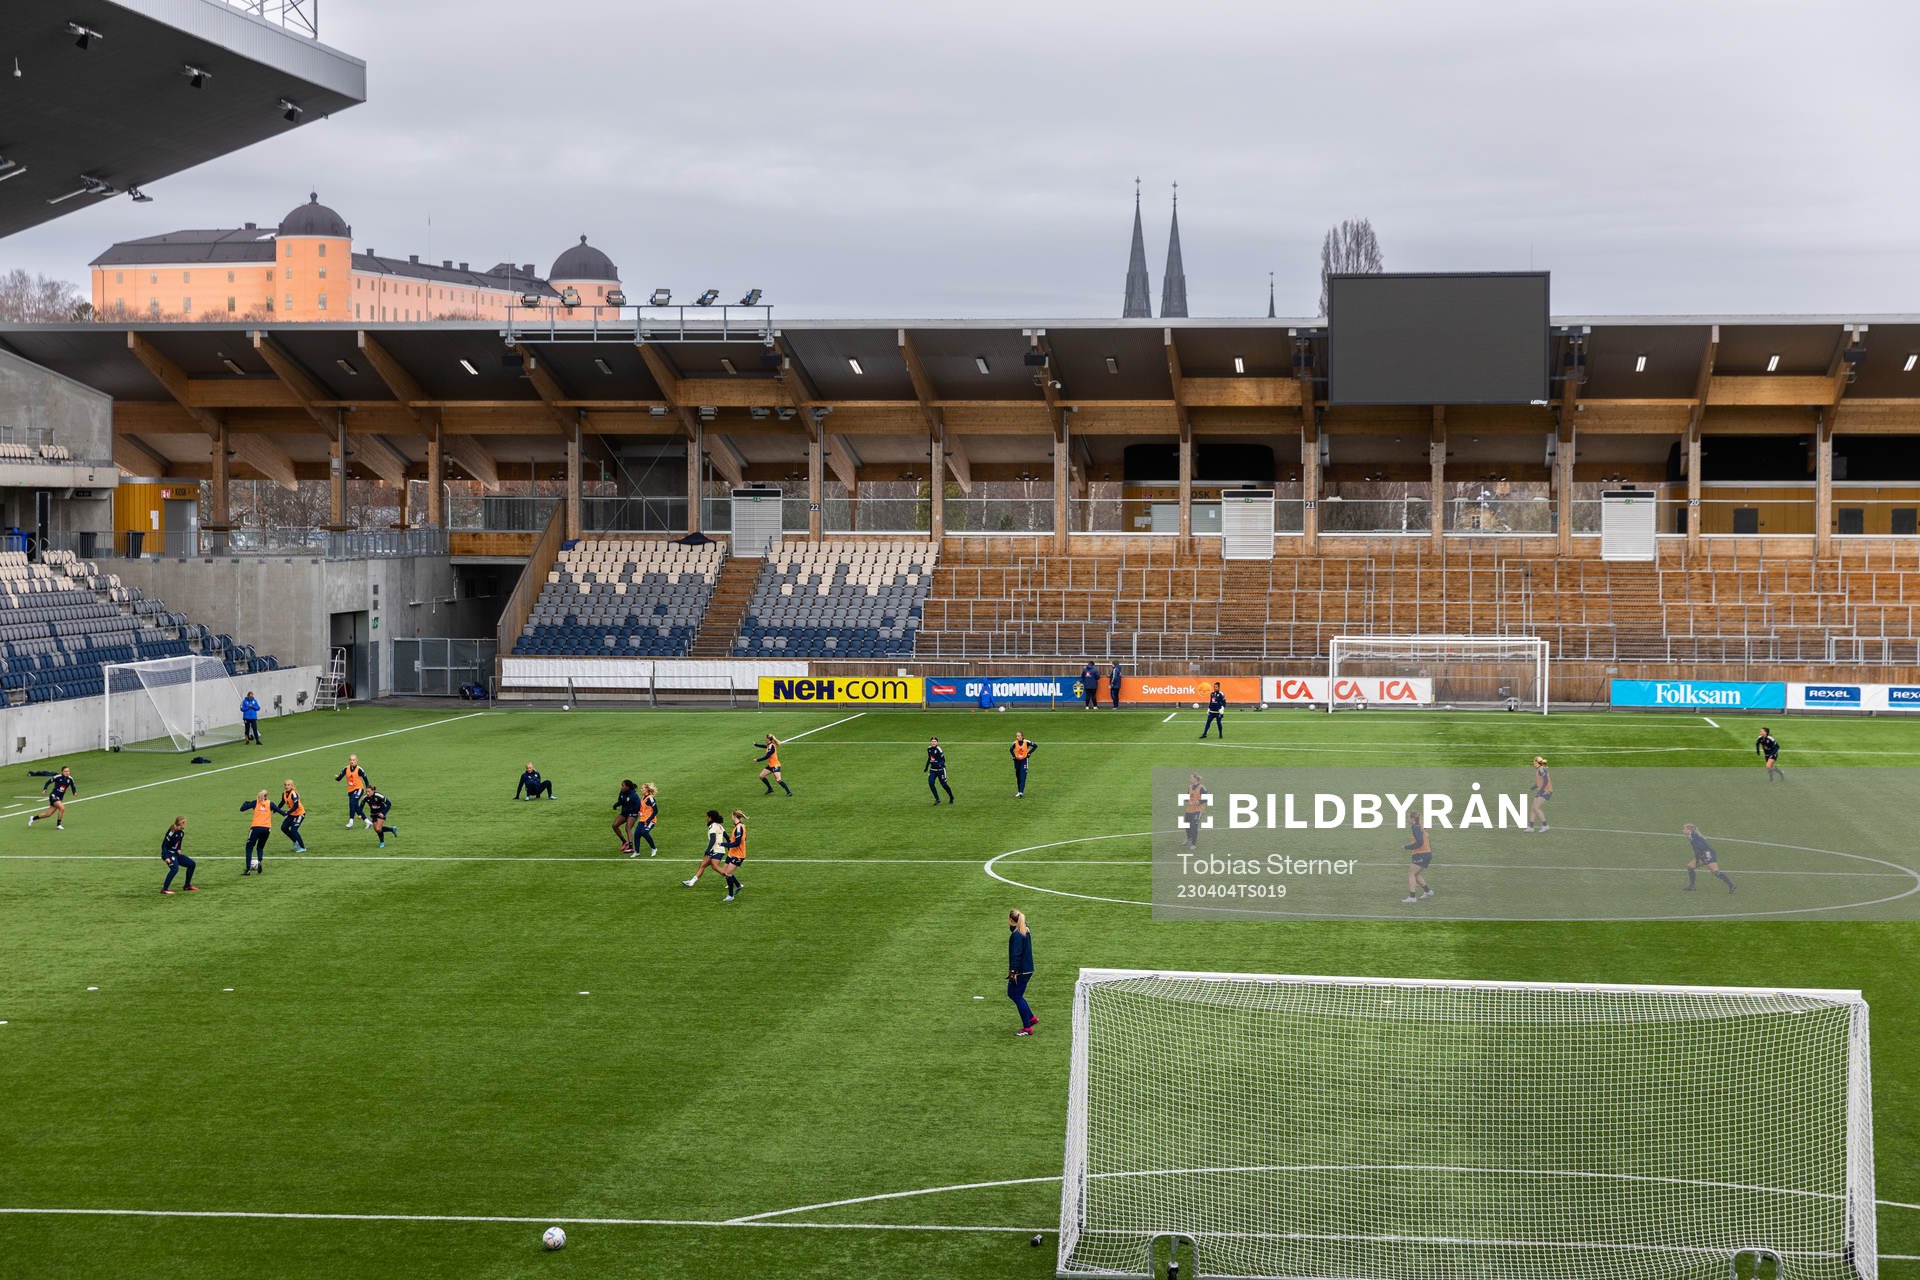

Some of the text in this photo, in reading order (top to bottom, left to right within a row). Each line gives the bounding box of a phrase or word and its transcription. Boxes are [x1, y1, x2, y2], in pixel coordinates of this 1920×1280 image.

[1305, 501, 1316, 509] 21
[965, 682, 1063, 697] CU KOMMUNAL
[1142, 684, 1195, 695] Swedbank
[1276, 680, 1313, 699] ICA
[1379, 680, 1416, 700] ICA
[1656, 683, 1741, 705] Folksam
